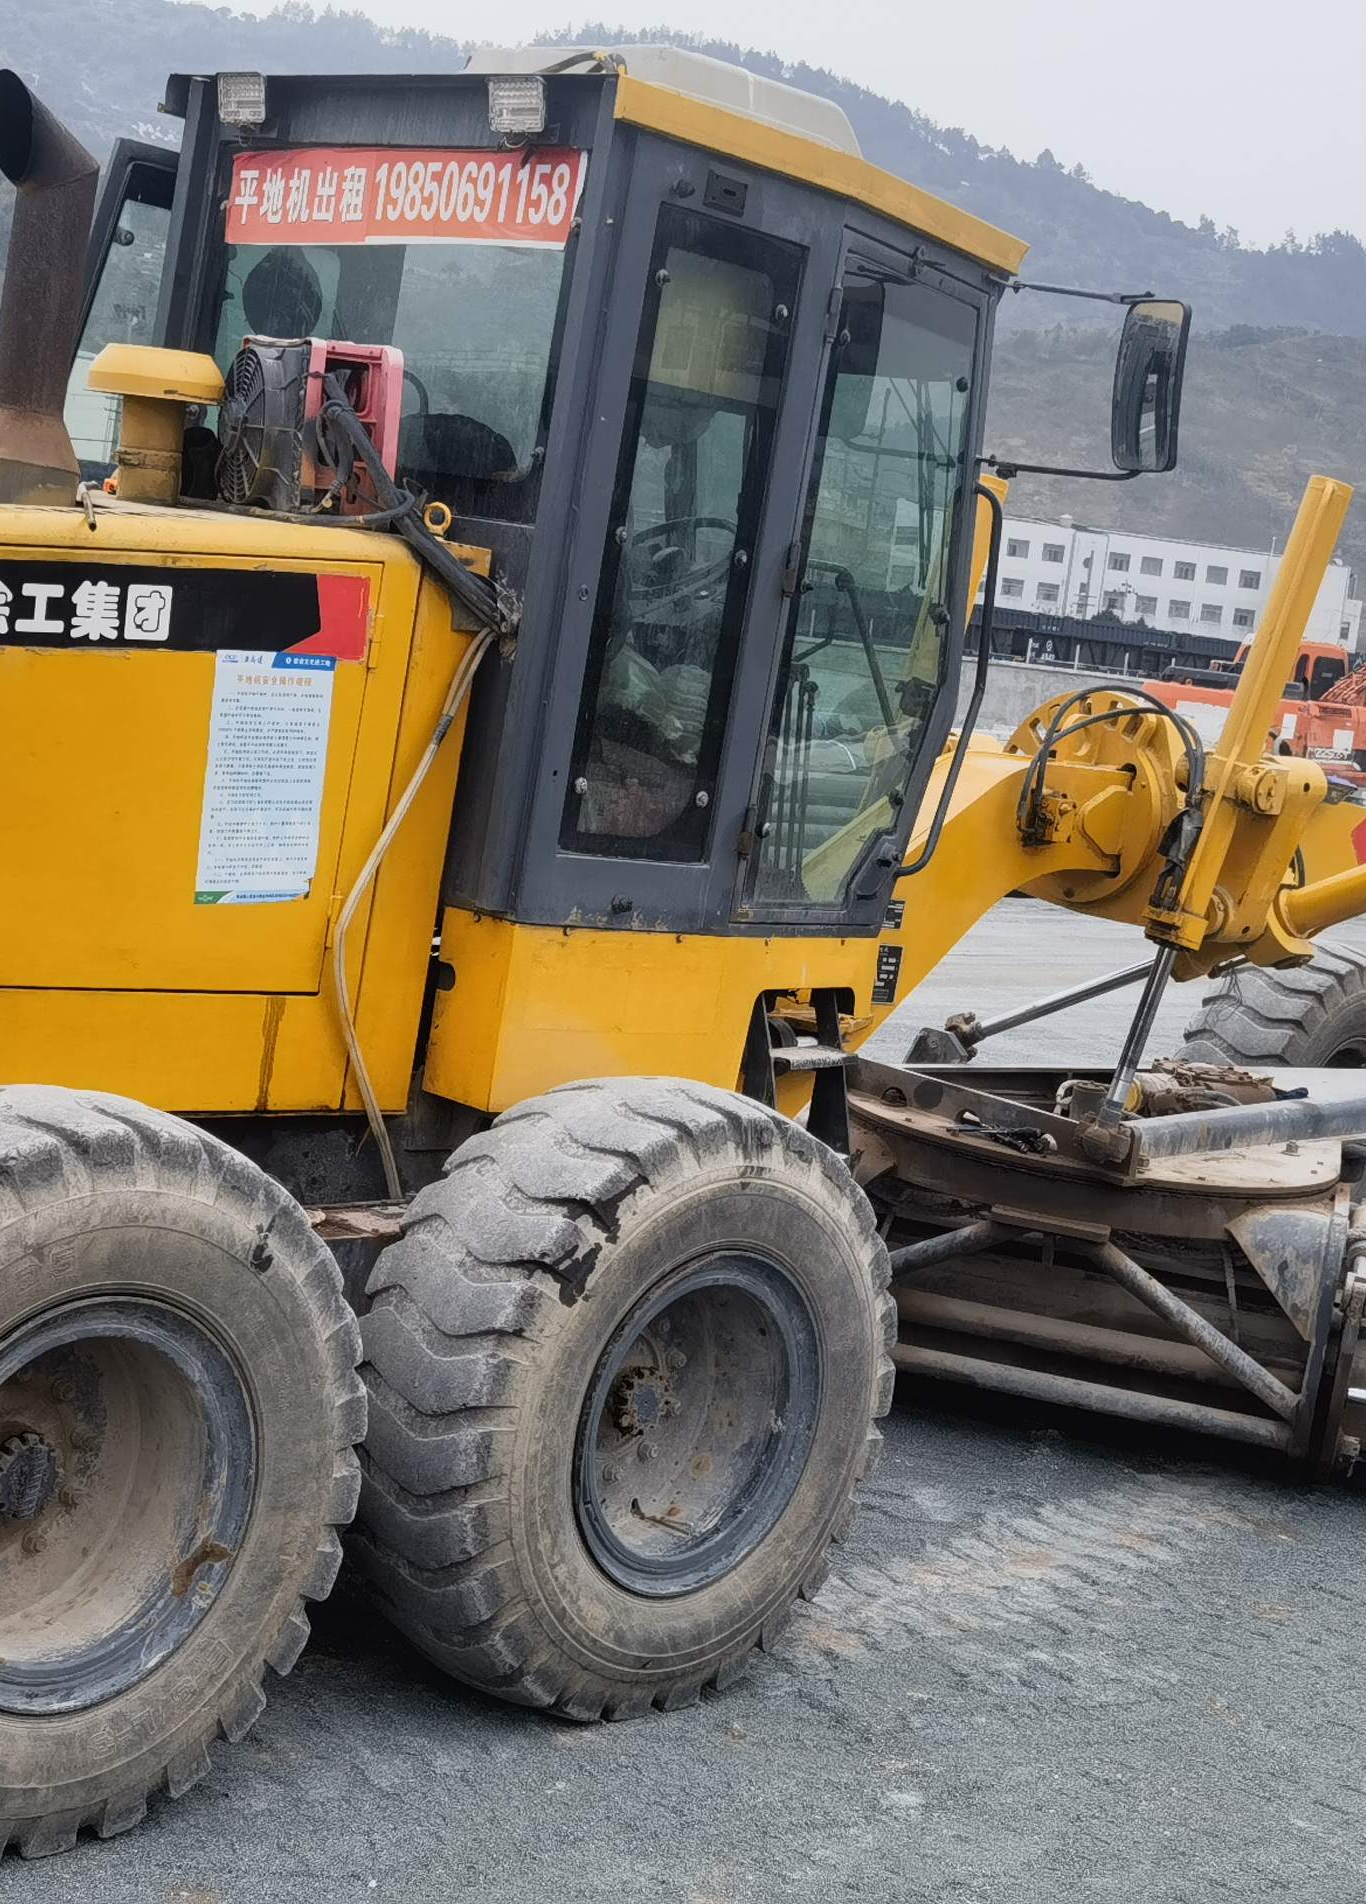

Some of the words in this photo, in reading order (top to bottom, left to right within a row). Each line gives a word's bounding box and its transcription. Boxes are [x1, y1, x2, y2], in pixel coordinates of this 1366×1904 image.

[234, 166, 368, 225] 平地机出租
[374, 160, 571, 226] 19850691158
